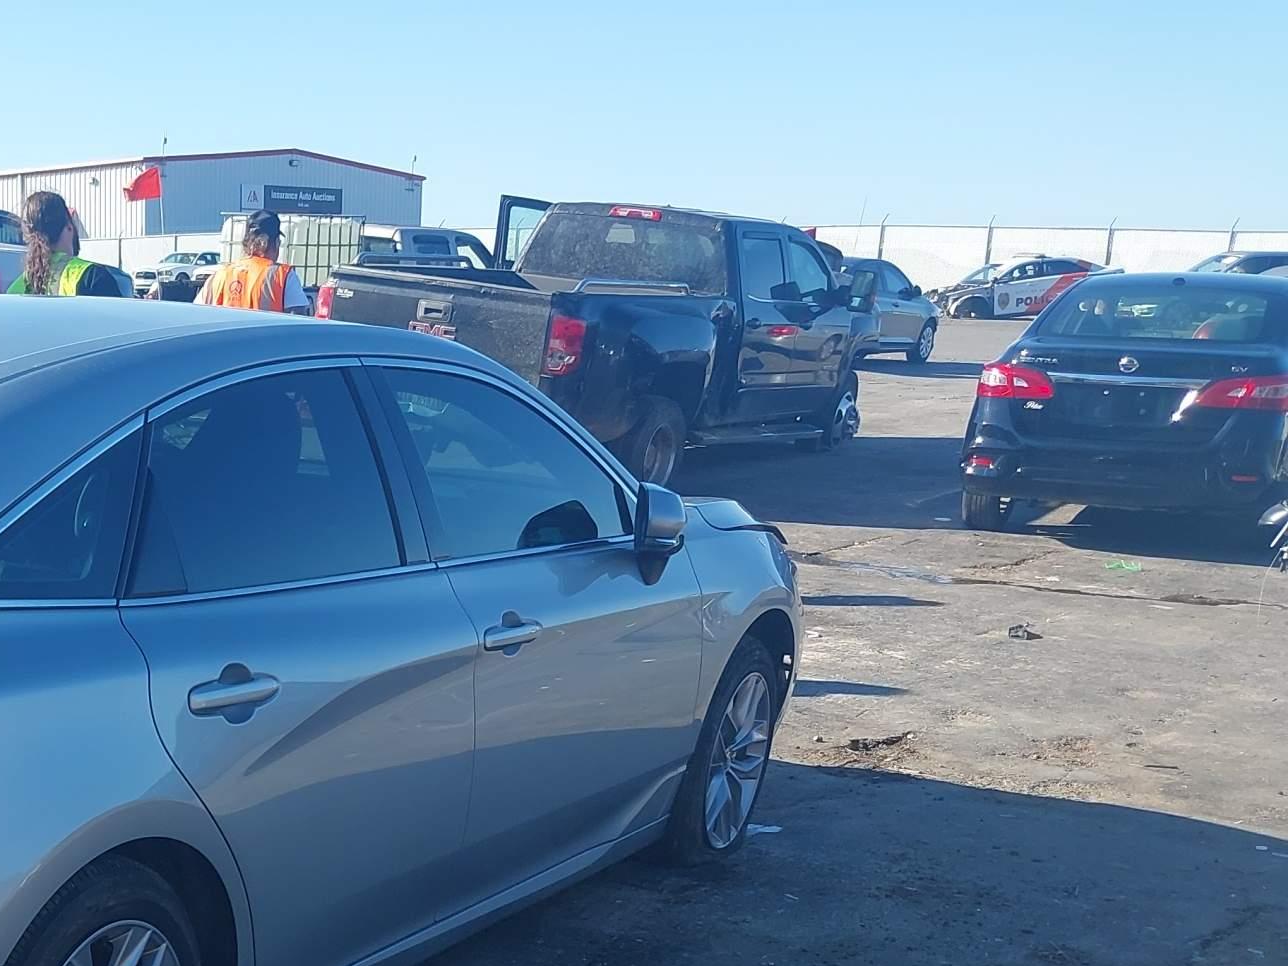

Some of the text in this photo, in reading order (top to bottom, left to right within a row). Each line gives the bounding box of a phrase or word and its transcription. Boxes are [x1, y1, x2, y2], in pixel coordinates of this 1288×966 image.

[271, 190, 336, 202] Insurance Auto Auctions
